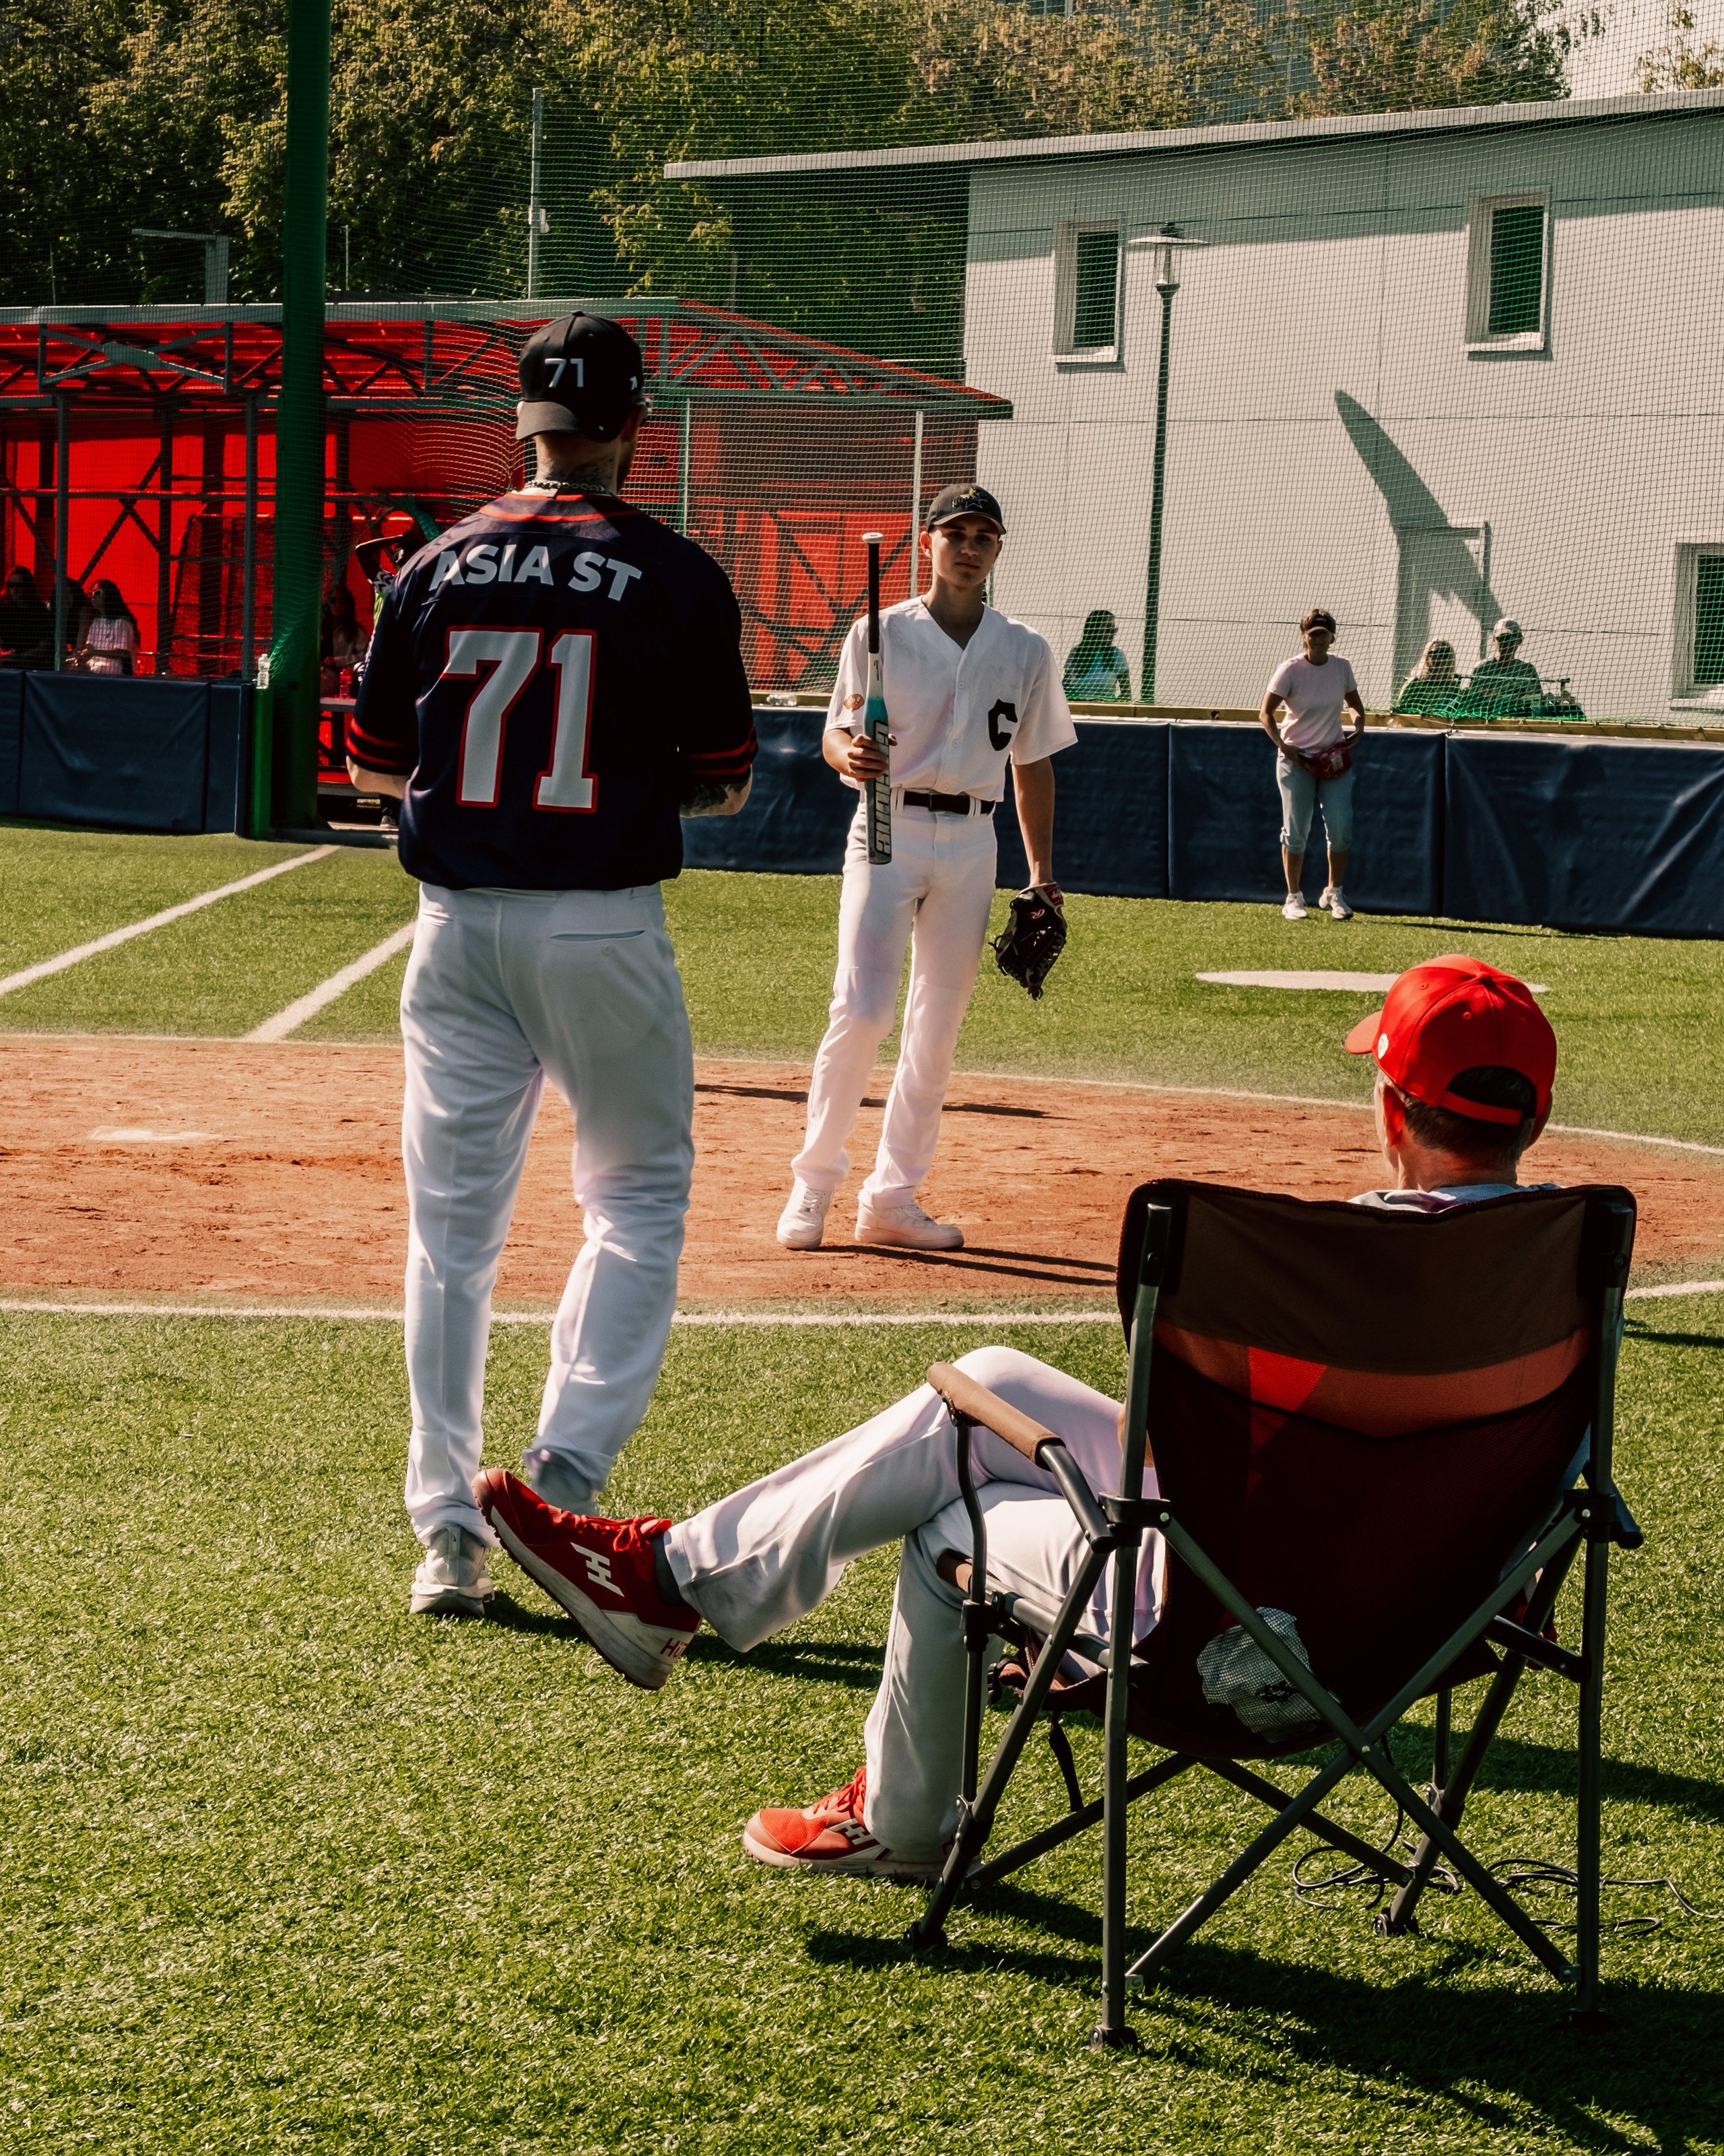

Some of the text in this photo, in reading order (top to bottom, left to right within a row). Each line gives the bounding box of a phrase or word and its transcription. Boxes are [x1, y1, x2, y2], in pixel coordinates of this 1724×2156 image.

[545, 358, 584, 388] 71
[428, 544, 642, 601] ASIA ST
[441, 626, 598, 813] 71
[988, 698, 1018, 752] C
